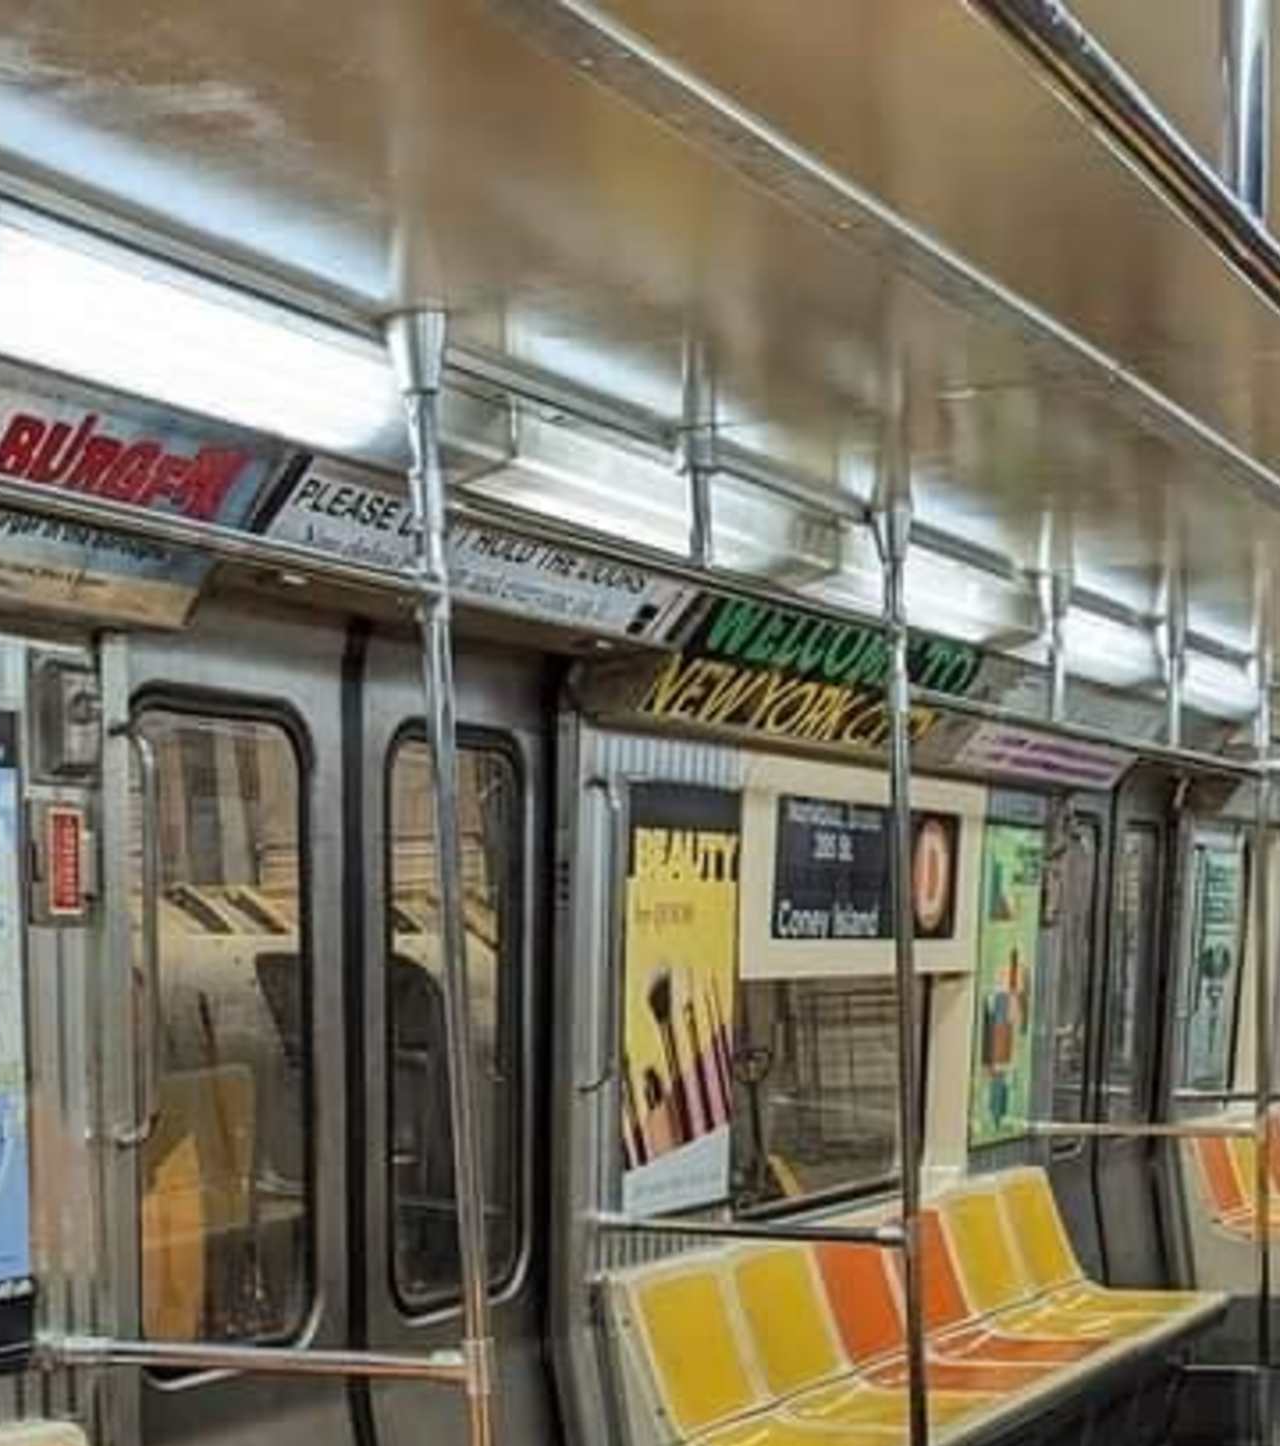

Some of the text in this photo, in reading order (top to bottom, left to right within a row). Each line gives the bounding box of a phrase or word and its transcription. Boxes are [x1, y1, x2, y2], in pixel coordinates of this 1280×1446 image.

[295, 479, 401, 531] PLEASE
[916, 640, 974, 696] TO
[642, 652, 762, 726] NEW
[748, 672, 860, 743] YORK
[633, 827, 739, 882] BEAUTY
[777, 900, 881, 939] Coney Island
